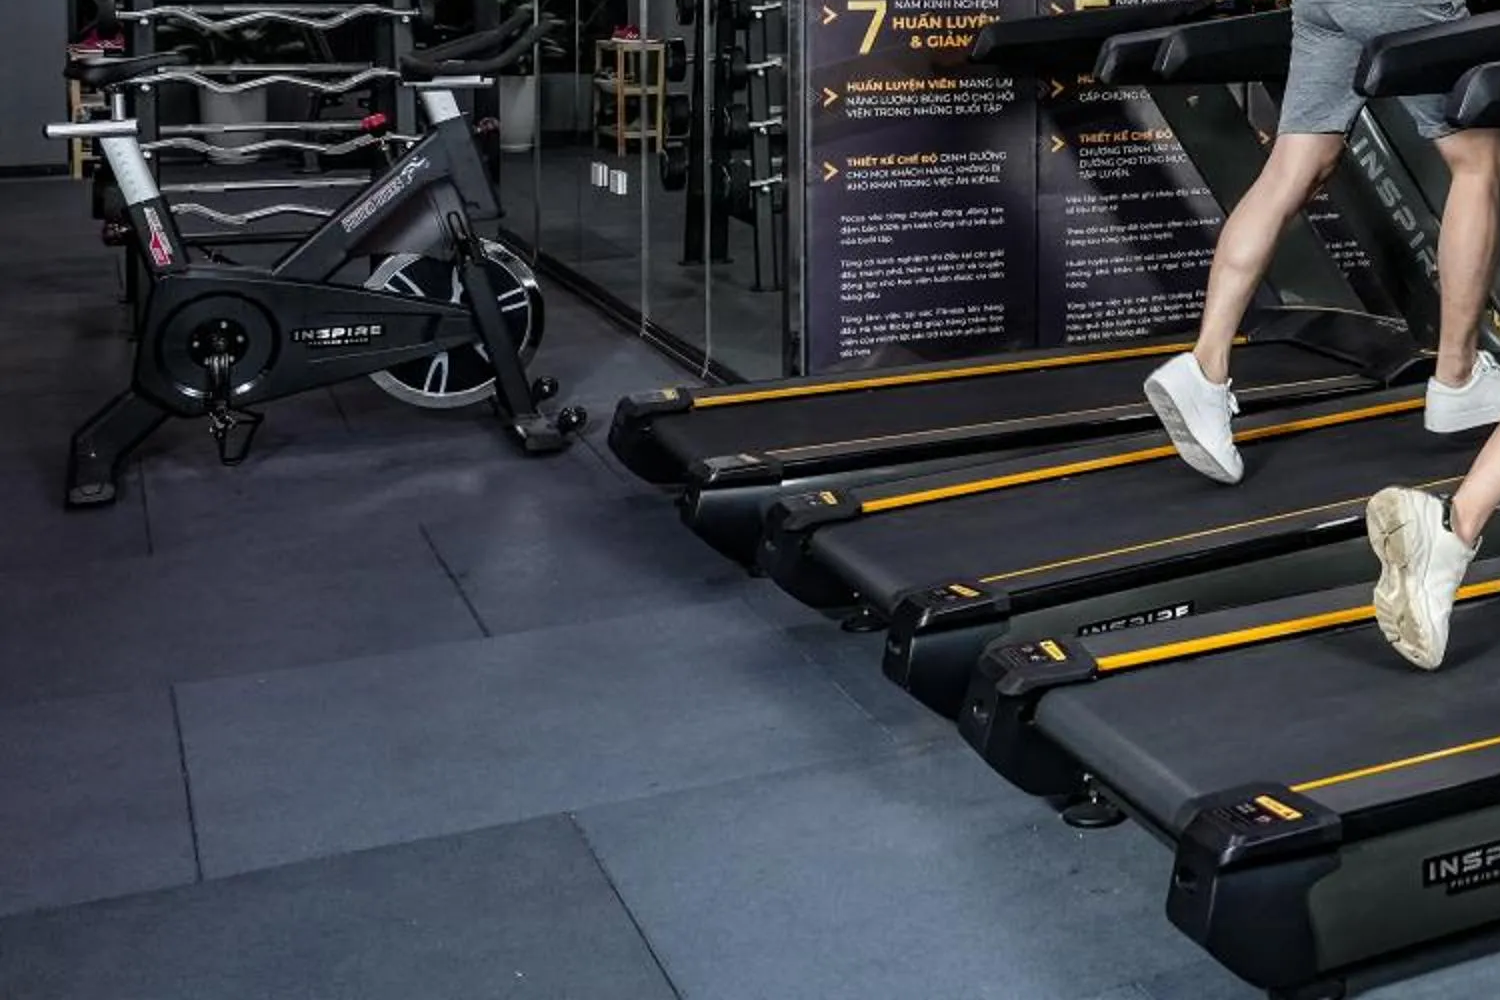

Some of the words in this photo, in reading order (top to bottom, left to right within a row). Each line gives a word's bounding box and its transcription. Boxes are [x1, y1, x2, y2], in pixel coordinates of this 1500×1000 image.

[847, 0, 887, 55] 7
[892, 13, 942, 30] HUẤN
[910, 35, 921, 48] &
[927, 30, 972, 48] GIẢN
[847, 78, 883, 92] HUẤN
[885, 77, 925, 92] LUYỆN
[1351, 136, 1438, 279] INSPIR
[294, 325, 382, 341] INSPIRE
